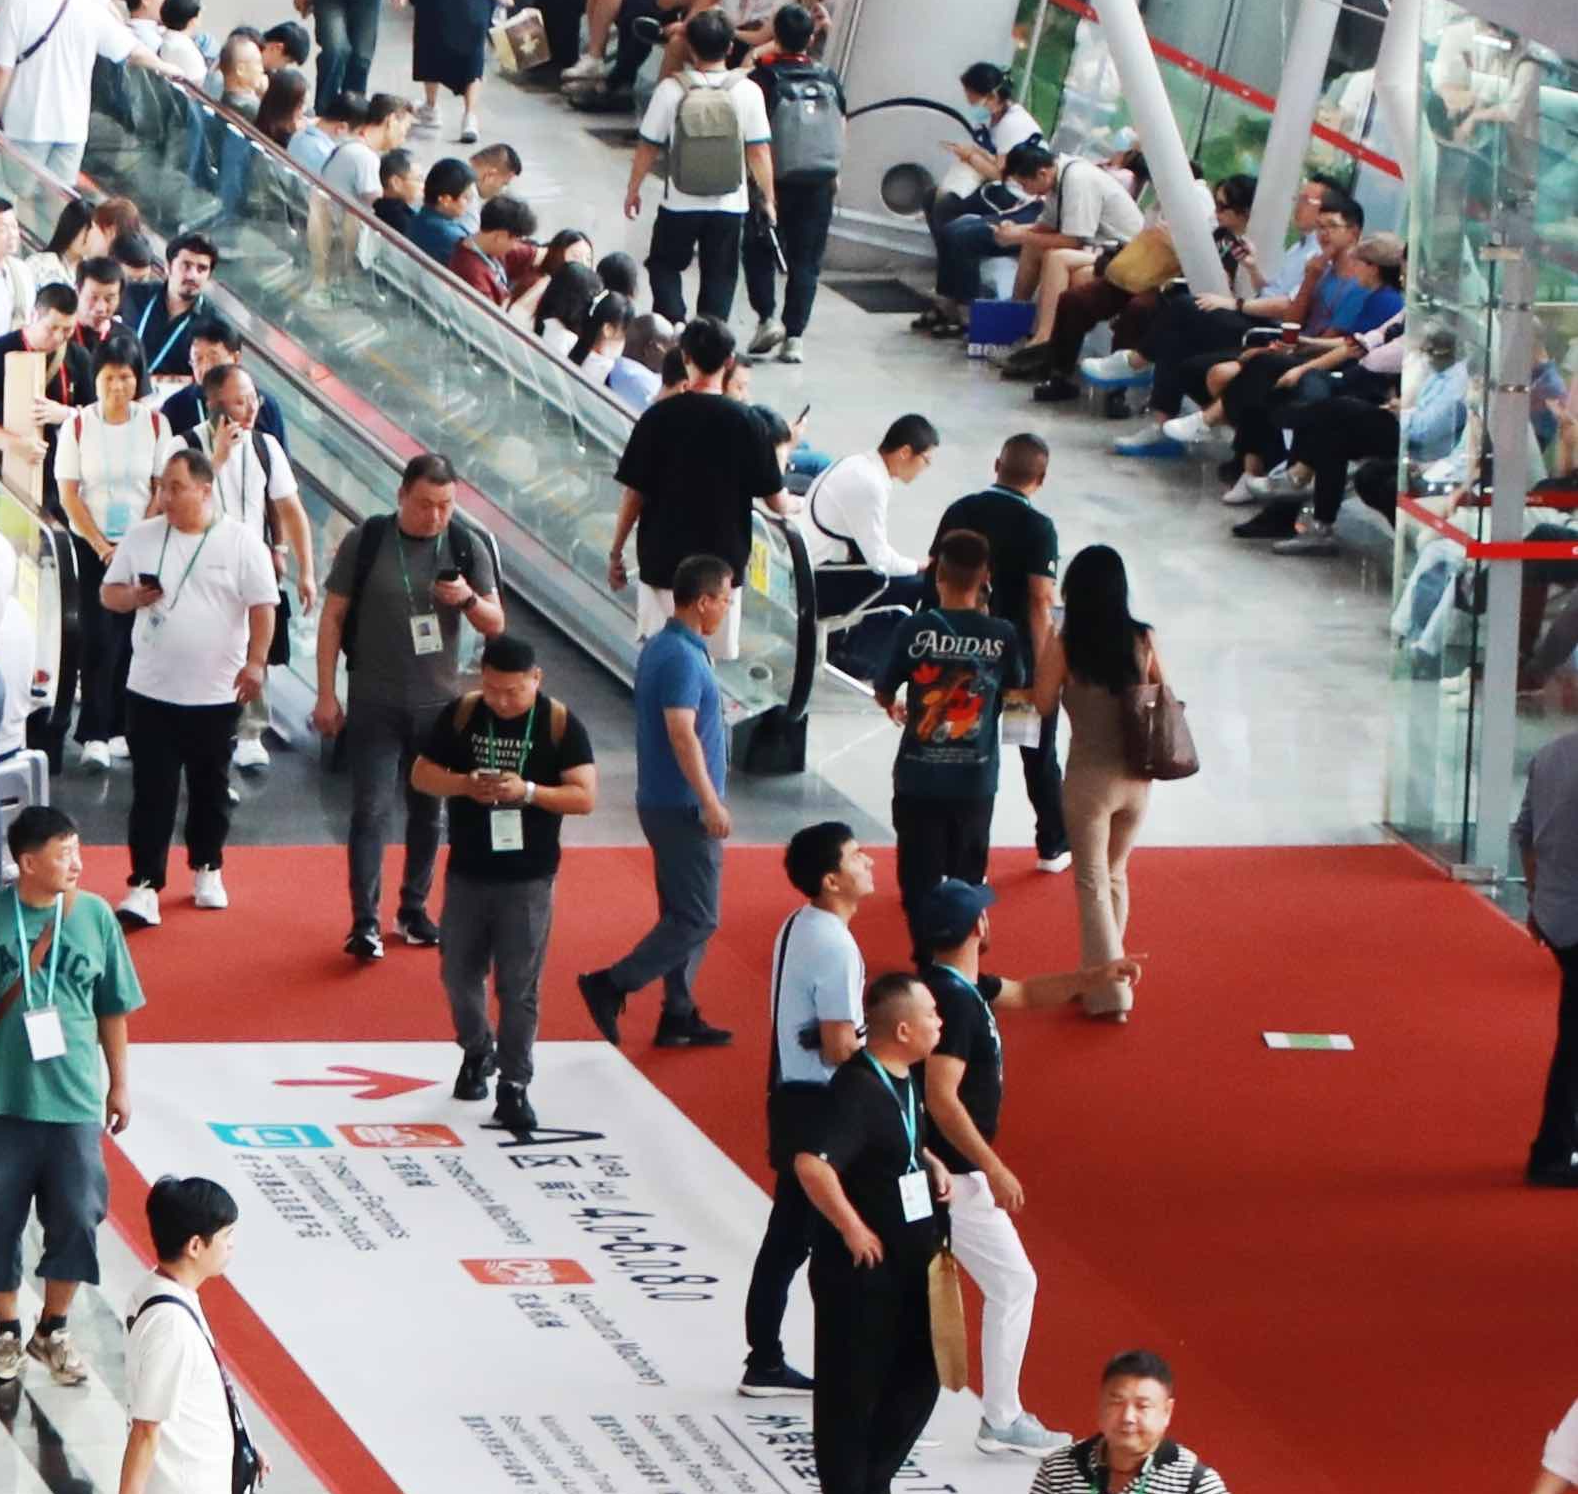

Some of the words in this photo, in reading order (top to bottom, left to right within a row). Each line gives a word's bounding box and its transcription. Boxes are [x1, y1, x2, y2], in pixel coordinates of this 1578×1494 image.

[908, 629, 1005, 659] ADIDAS
[479, 1124, 605, 1148] A
[584, 1153, 631, 1177] Area
[508, 1155, 582, 1170] 区
